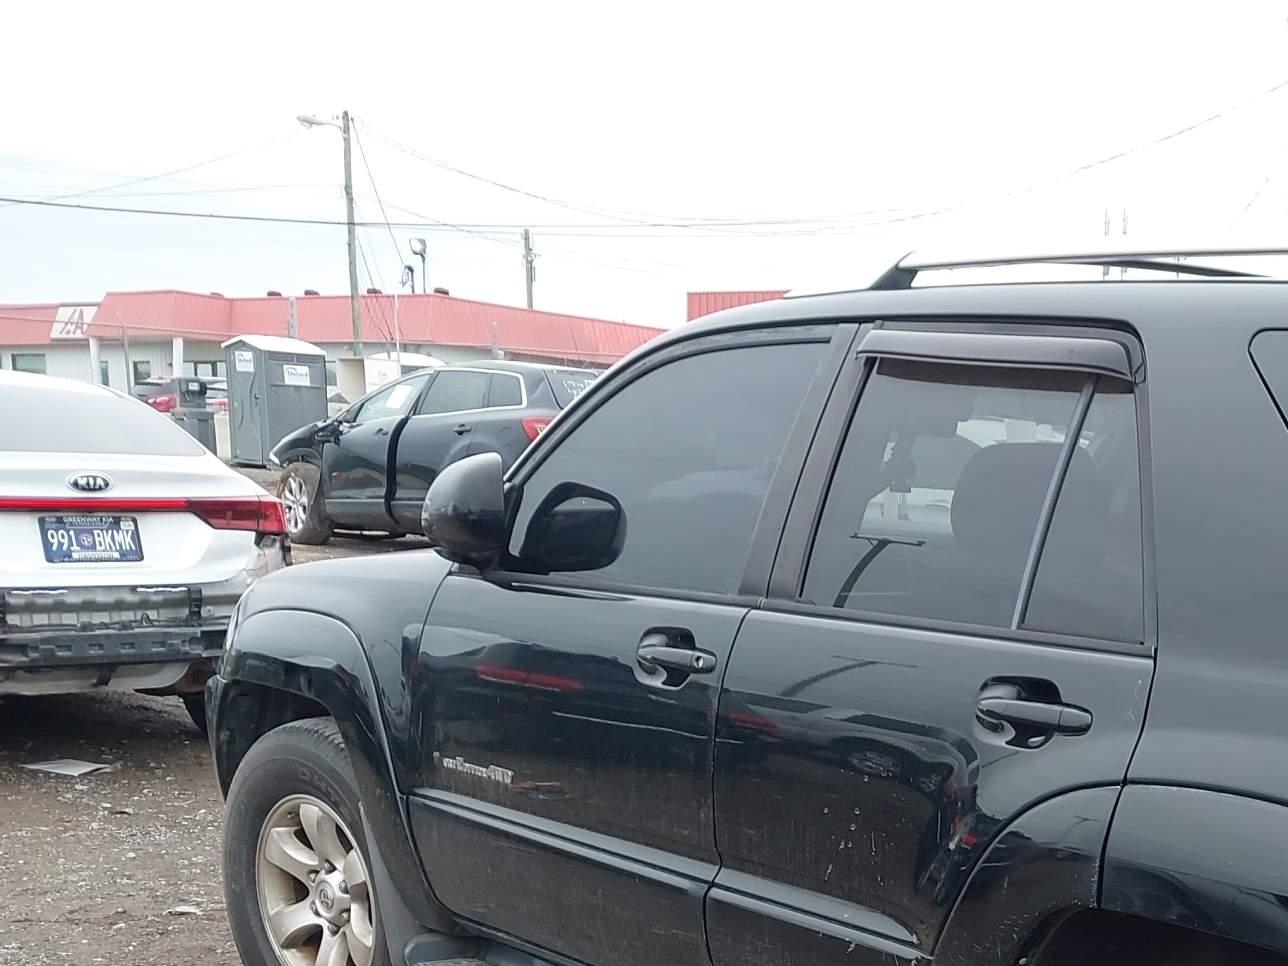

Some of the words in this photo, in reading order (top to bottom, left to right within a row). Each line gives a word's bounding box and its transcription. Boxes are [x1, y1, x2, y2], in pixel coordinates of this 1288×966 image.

[77, 476, 105, 489] KIA
[62, 515, 101, 523] GREENWAY
[47, 529, 81, 551] 991
[92, 529, 136, 551] BKMK
